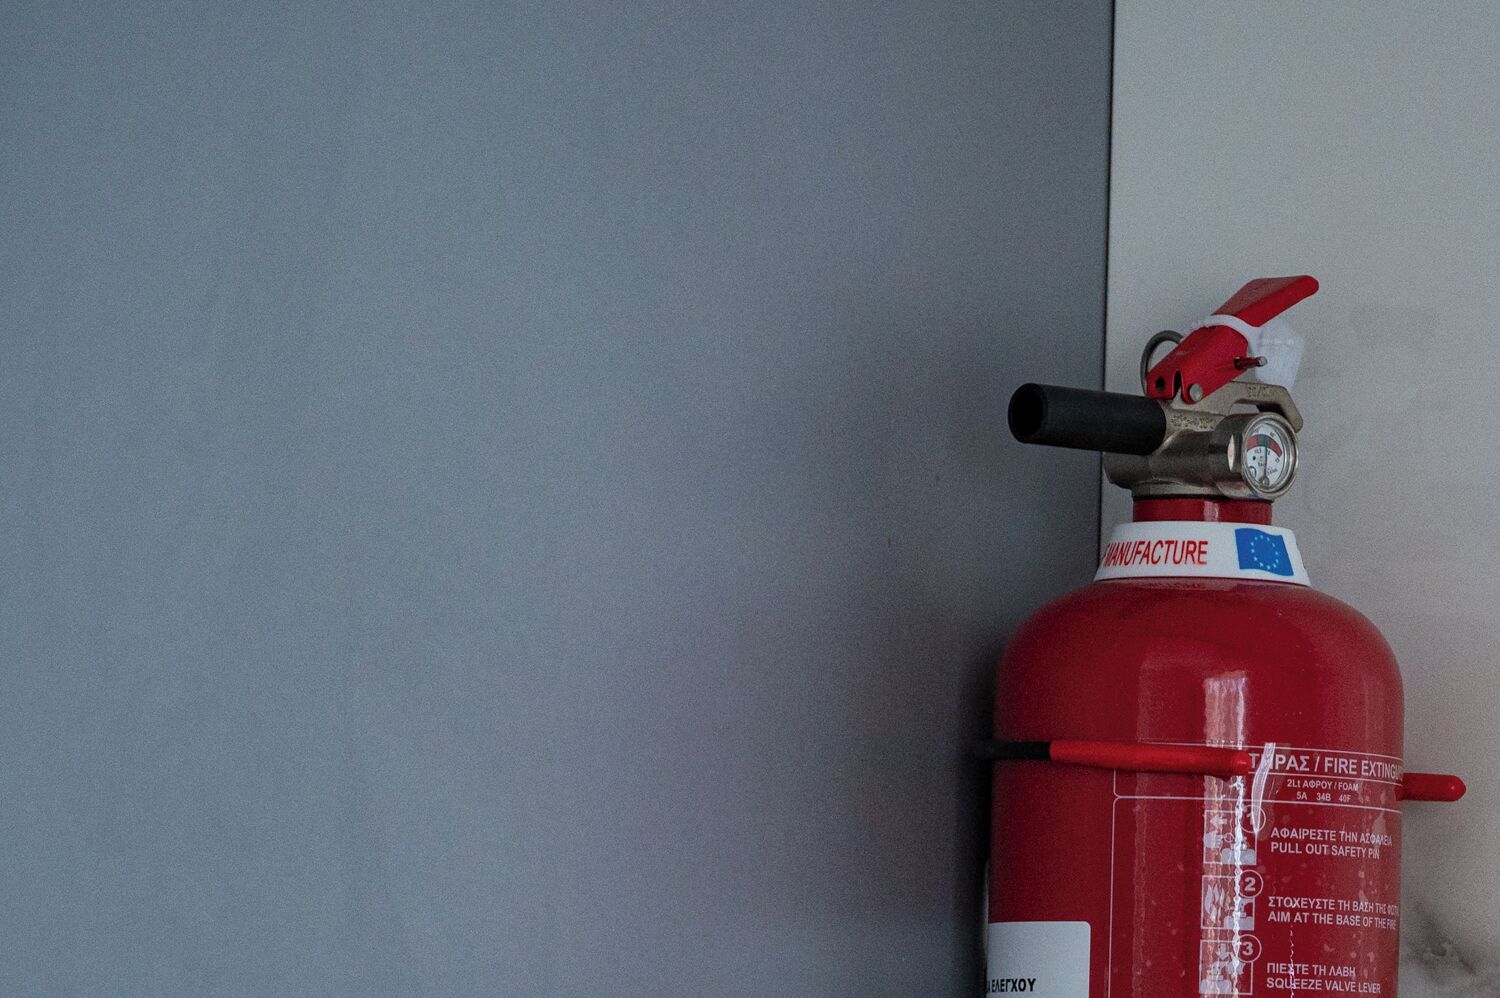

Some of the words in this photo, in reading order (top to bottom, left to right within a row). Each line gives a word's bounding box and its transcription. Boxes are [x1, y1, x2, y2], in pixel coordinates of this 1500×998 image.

[1104, 540, 1208, 566] MANUFACTURE
[1314, 756, 1320, 772] /
[1324, 757, 1358, 775] FIRE
[1302, 780, 1333, 790] ΑΦΡΟΥ
[1338, 782, 1359, 792] FOAM
[1296, 792, 1308, 801] 5A
[1316, 792, 1332, 801] 34B
[1271, 827, 1336, 842] ΑΦΑΙΡΕΣΤΕ
[1339, 830, 1358, 842] ΤΗΝ
[1271, 842, 1302, 854] PULL
[1306, 844, 1327, 856] OUT
[1332, 845, 1366, 858] SAFETY
[1368, 848, 1380, 860] PIN
[1244, 876, 1256, 891] 2
[1268, 896, 1335, 911] ΣΤΟΧΕΥΣΤΕ
[1338, 900, 1350, 910] ΤΗ
[1352, 901, 1374, 913] ΒΑΣΗ
[1268, 912, 1290, 923] AIM
[1294, 912, 1310, 923] AT
[1312, 912, 1333, 924] THE
[1336, 914, 1360, 926] BASE
[1362, 916, 1373, 927] OF
[1374, 917, 1387, 928] THE
[1244, 942, 1254, 956] 3
[1266, 962, 1310, 975] ΠΙΕΣΤΕ
[1312, 964, 1326, 976] ΤΗ
[1329, 966, 1356, 978] ΛΑΒΗ
[992, 978, 1036, 992] ΕΛΕΓΧΟΥ
[1266, 978, 1322, 991] SQUEEZE
[1326, 980, 1356, 992] VALVE
[1358, 982, 1381, 994] LEVER
